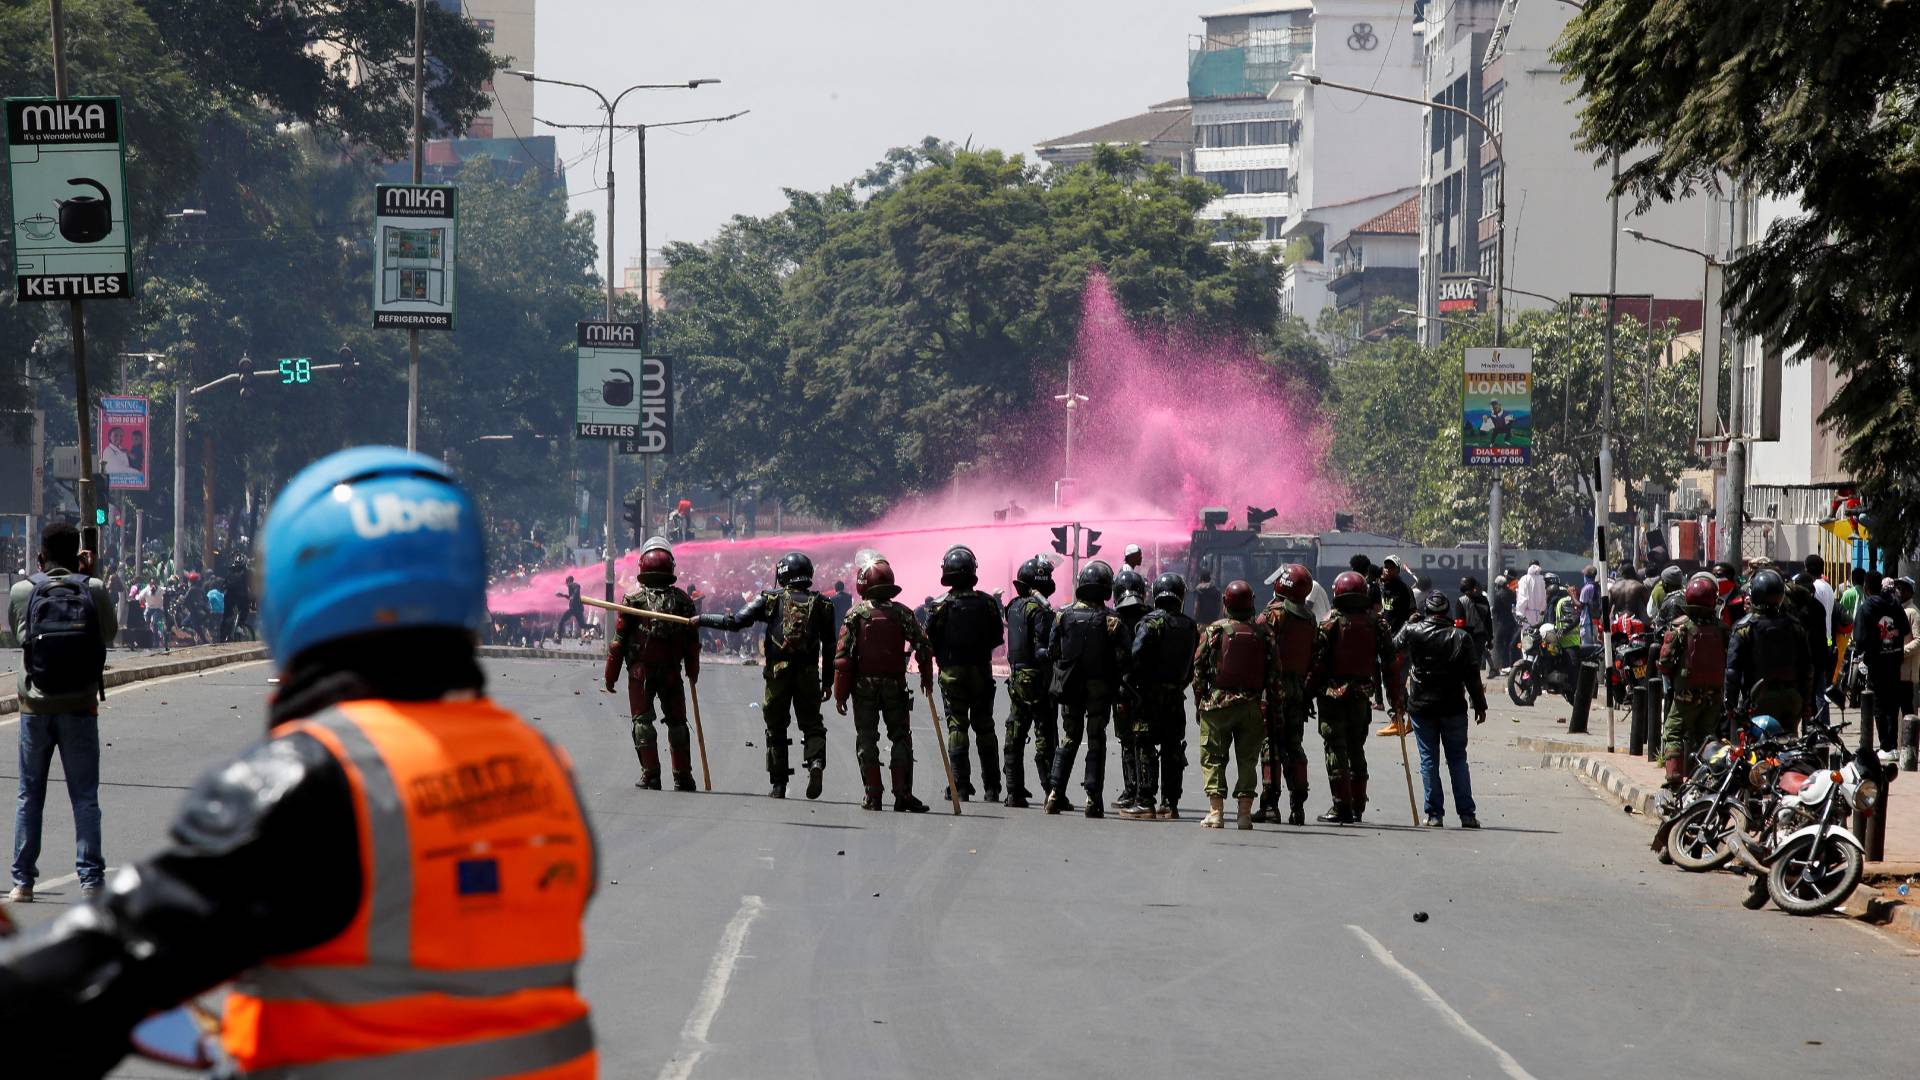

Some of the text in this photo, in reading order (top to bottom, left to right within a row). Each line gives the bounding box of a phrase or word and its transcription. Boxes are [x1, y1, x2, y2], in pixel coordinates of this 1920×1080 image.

[22, 104, 105, 131] MIKA
[43, 132, 81, 140] Wonderful
[385, 188, 445, 208] MIKA
[26, 276, 120, 296] KETTLES
[1439, 283, 1475, 300] JAVA
[378, 314, 448, 324] REFRIGERATORS
[586, 325, 635, 341] MIKA
[279, 359, 311, 384] 58
[1468, 373, 1527, 381] TITLE DEED
[1468, 381, 1527, 395] LOANS
[638, 358, 667, 453] MIKA
[581, 424, 635, 436] KETTLES
[1476, 448, 1495, 456] DIAL
